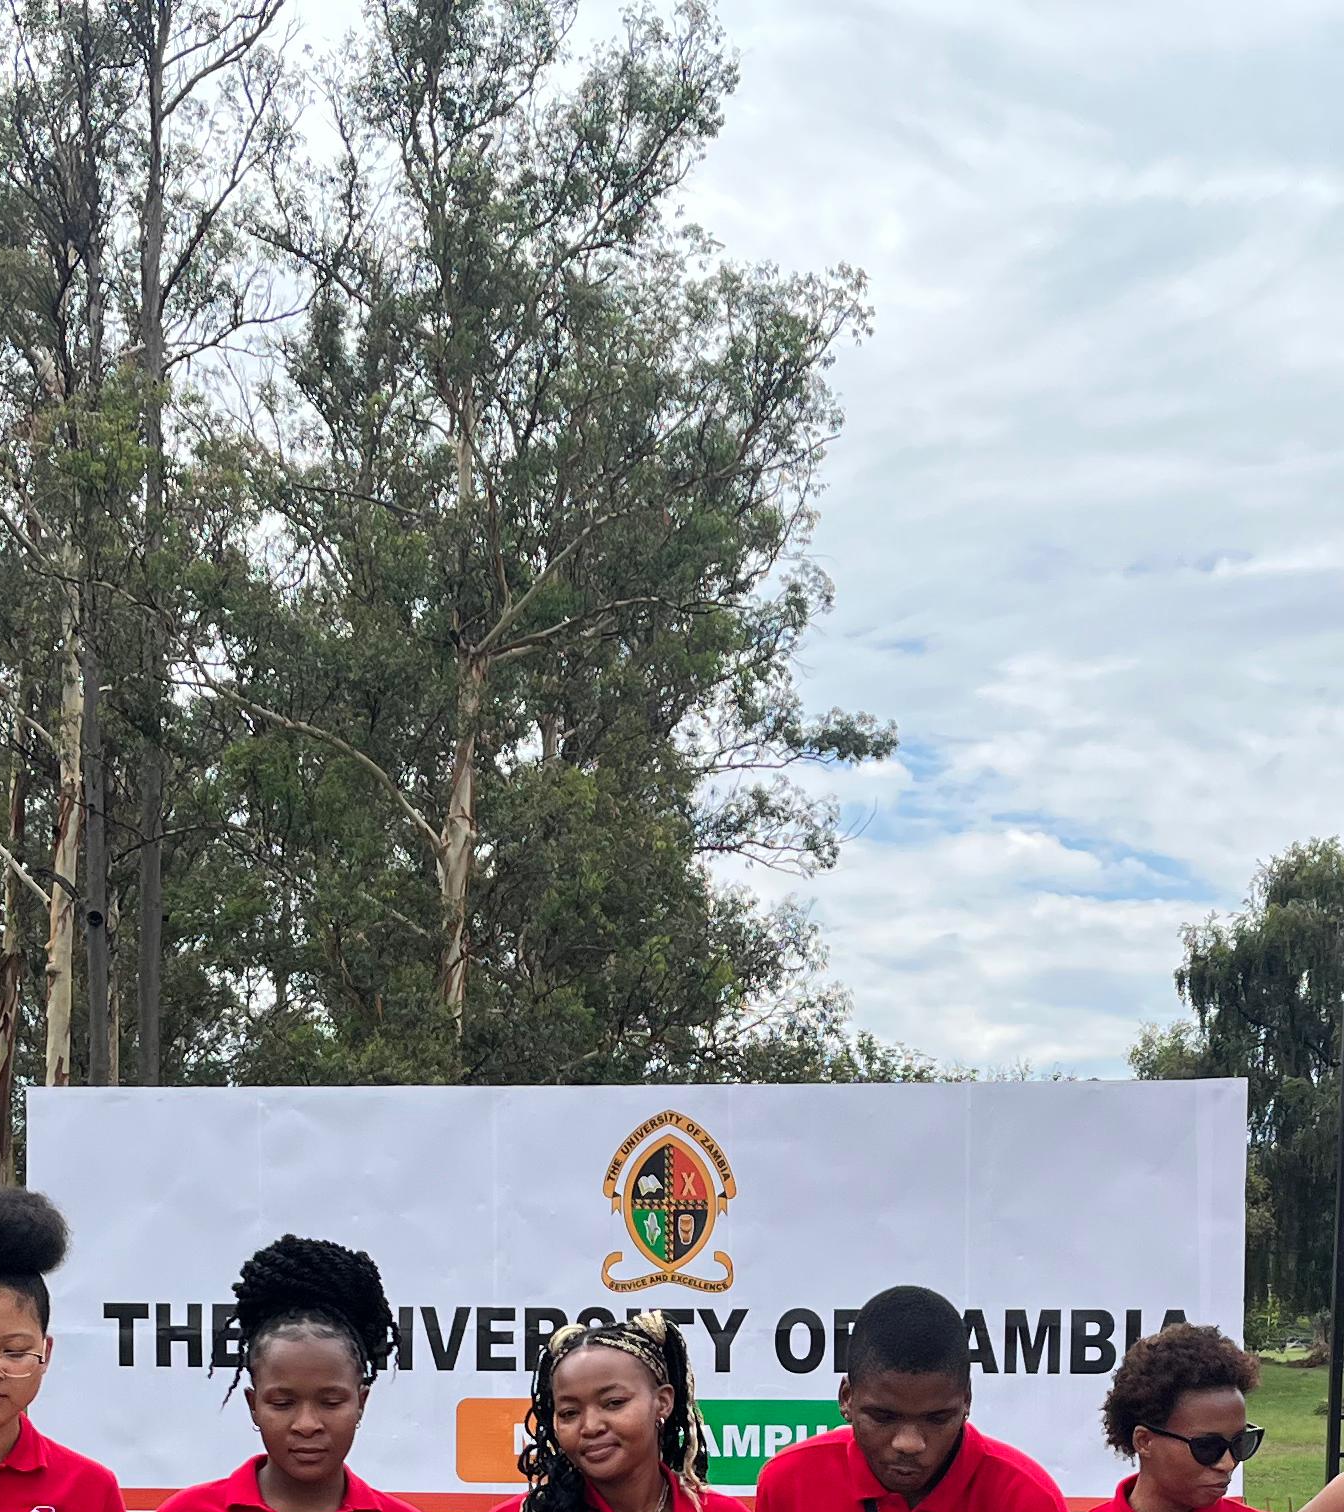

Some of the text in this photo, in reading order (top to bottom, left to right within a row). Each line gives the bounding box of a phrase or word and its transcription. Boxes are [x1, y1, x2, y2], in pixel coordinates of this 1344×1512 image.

[607, 1112, 731, 1182] THE UNIVERSITY OF ZAMBIA
[608, 1274, 728, 1292] SERVICE AND EXCELLENCE
[104, 1302, 242, 1369] THE
